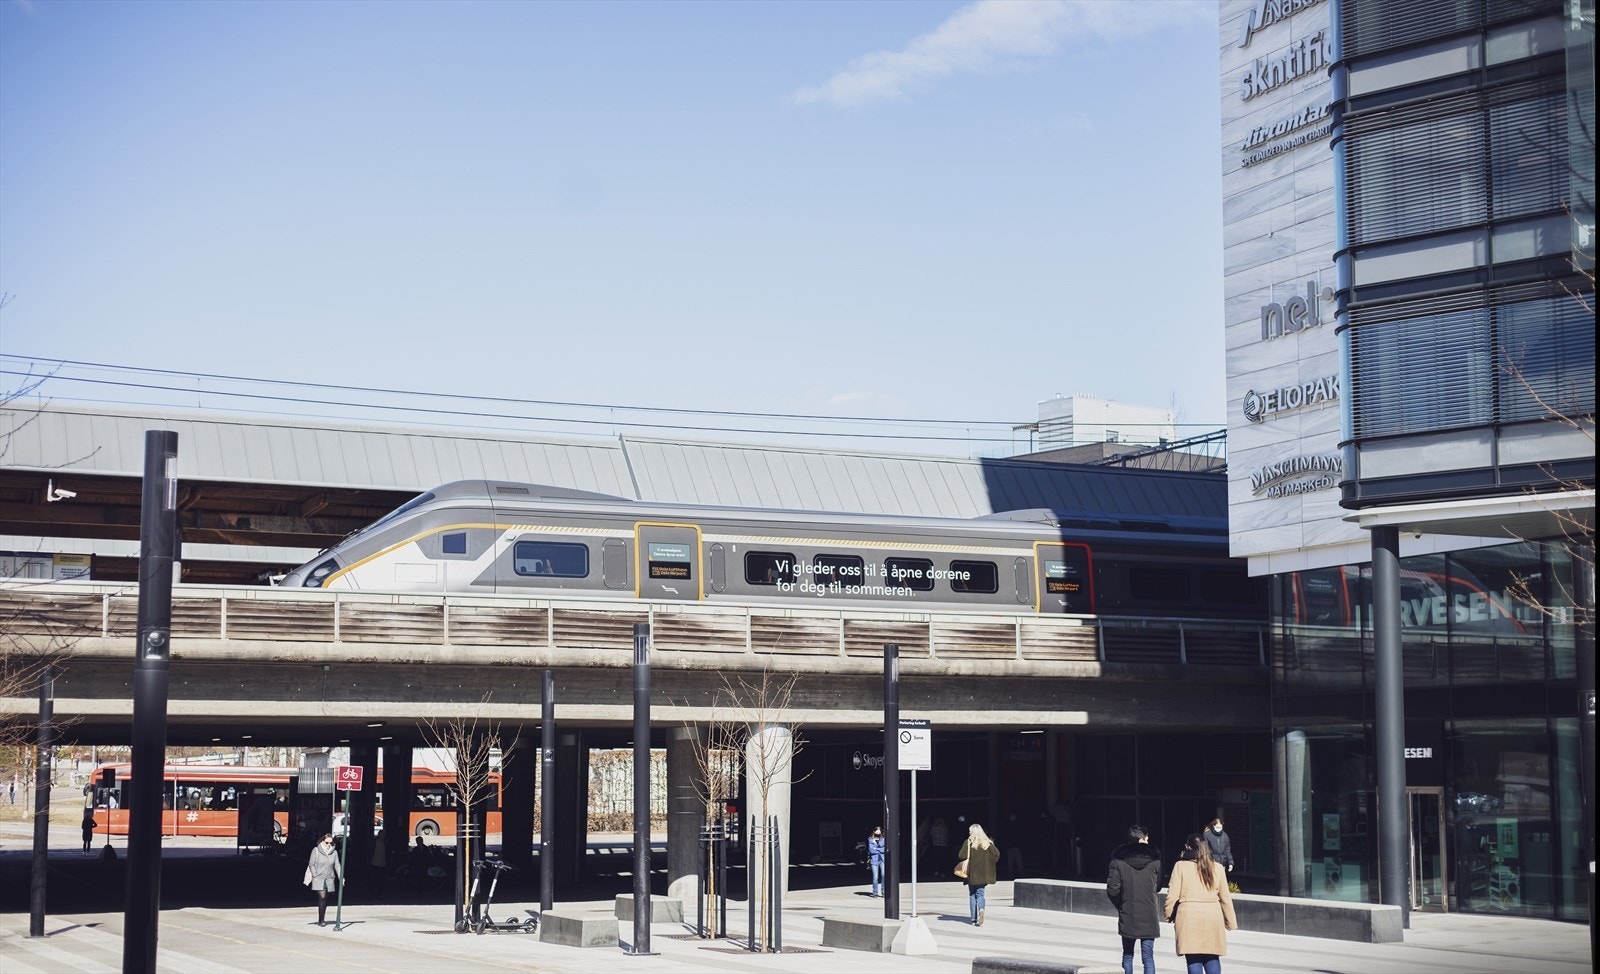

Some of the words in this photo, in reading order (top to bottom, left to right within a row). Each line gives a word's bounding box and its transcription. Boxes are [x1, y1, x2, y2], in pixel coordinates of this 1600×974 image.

[1261, 280, 1319, 340] nel
[1264, 375, 1340, 414] ELOPAK
[1250, 455, 1342, 491] MASCHMANN
[1266, 477, 1329, 498] MATMARKED
[775, 560, 789, 573] Vi
[792, 560, 836, 577] gleder
[839, 566, 860, 576] oss
[863, 563, 876, 576] til
[880, 563, 888, 577] å
[891, 564, 923, 582] åpne
[926, 566, 971, 580] dørene
[776, 578, 796, 592] for
[800, 579, 825, 597] deg
[829, 580, 841, 594] til
[845, 585, 916, 597] sommeren.
